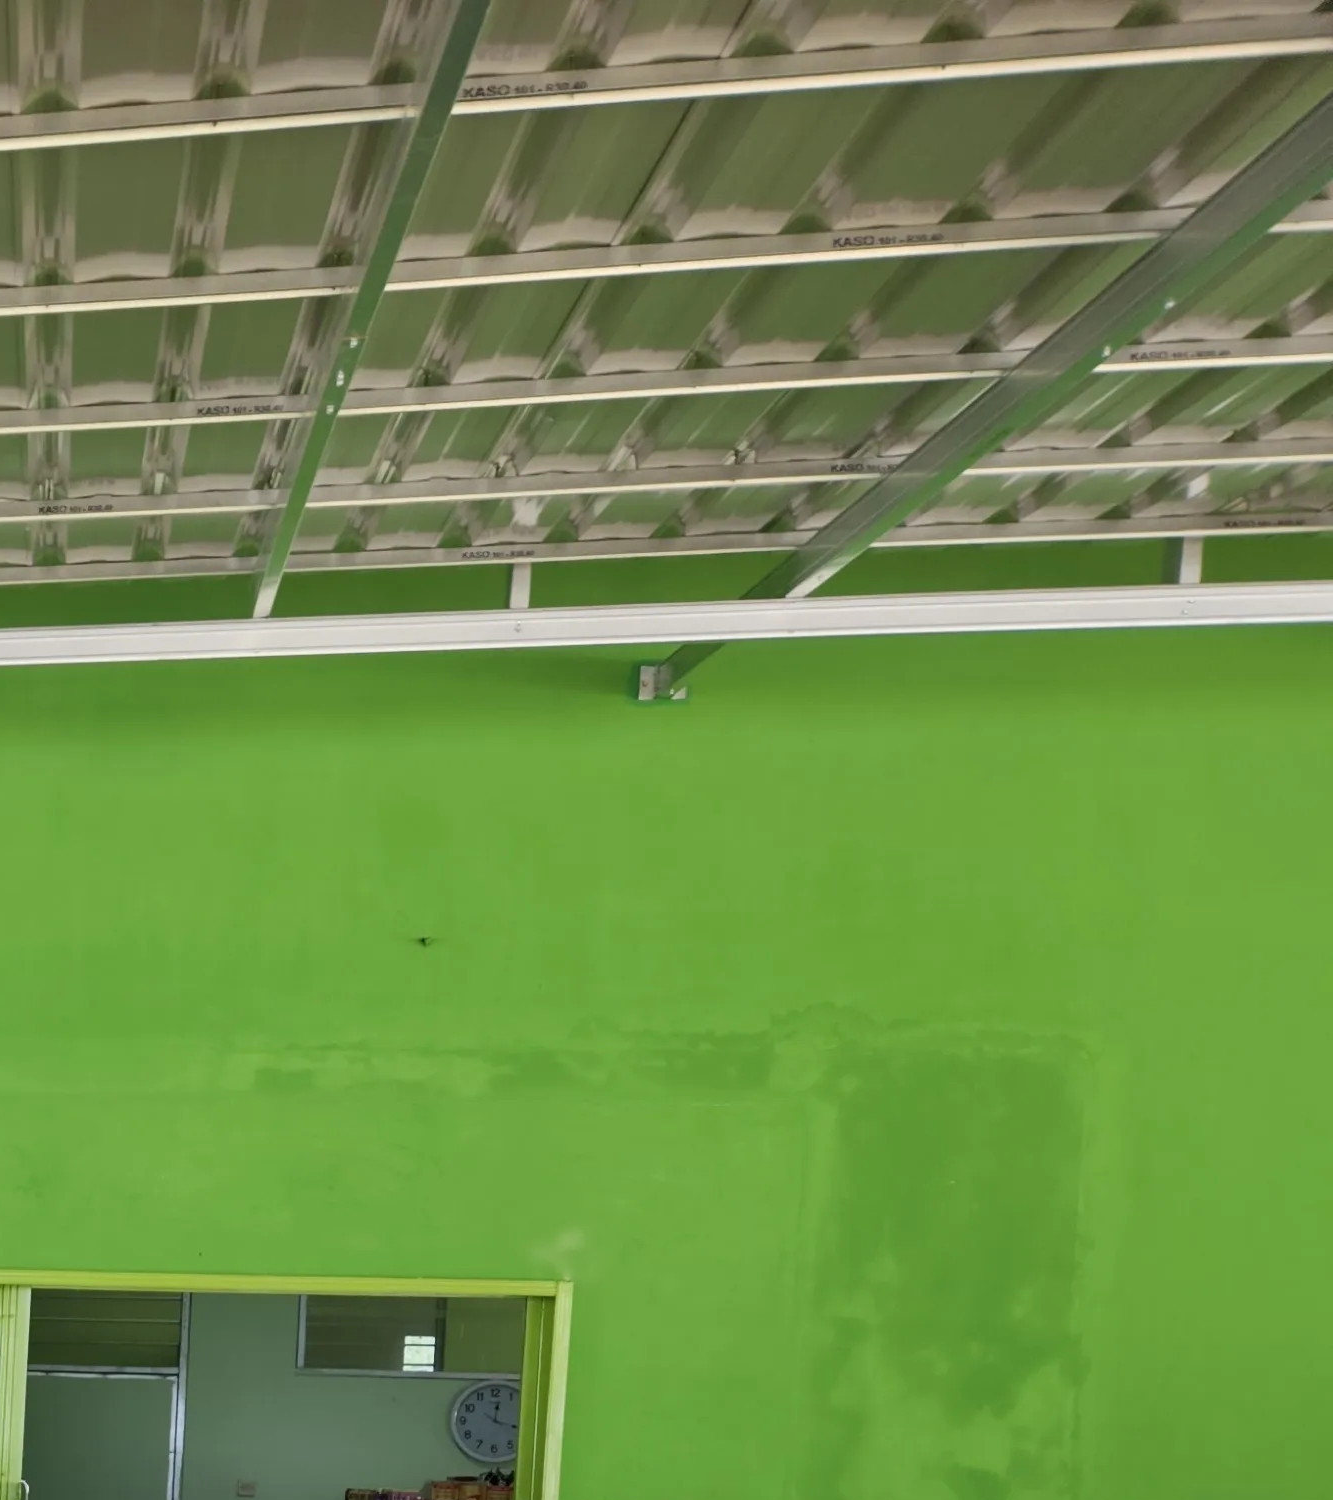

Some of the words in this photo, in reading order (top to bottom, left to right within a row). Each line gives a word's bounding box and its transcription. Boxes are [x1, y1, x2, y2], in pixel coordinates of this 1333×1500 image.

[462, 84, 511, 98] KASO
[832, 235, 875, 248] KASO
[197, 405, 230, 416] KASO
[830, 463, 865, 473] KASO
[38, 505, 67, 514] KASO
[461, 550, 490, 559] KASO
[476, 1392, 484, 1401] 11
[490, 1388, 500, 1398] 12
[465, 1403, 475, 1413] 10
[459, 1416, 466, 1425] 9
[464, 1430, 472, 1440] 8
[476, 1439, 483, 1449] 7
[490, 1444, 498, 1453] 6
